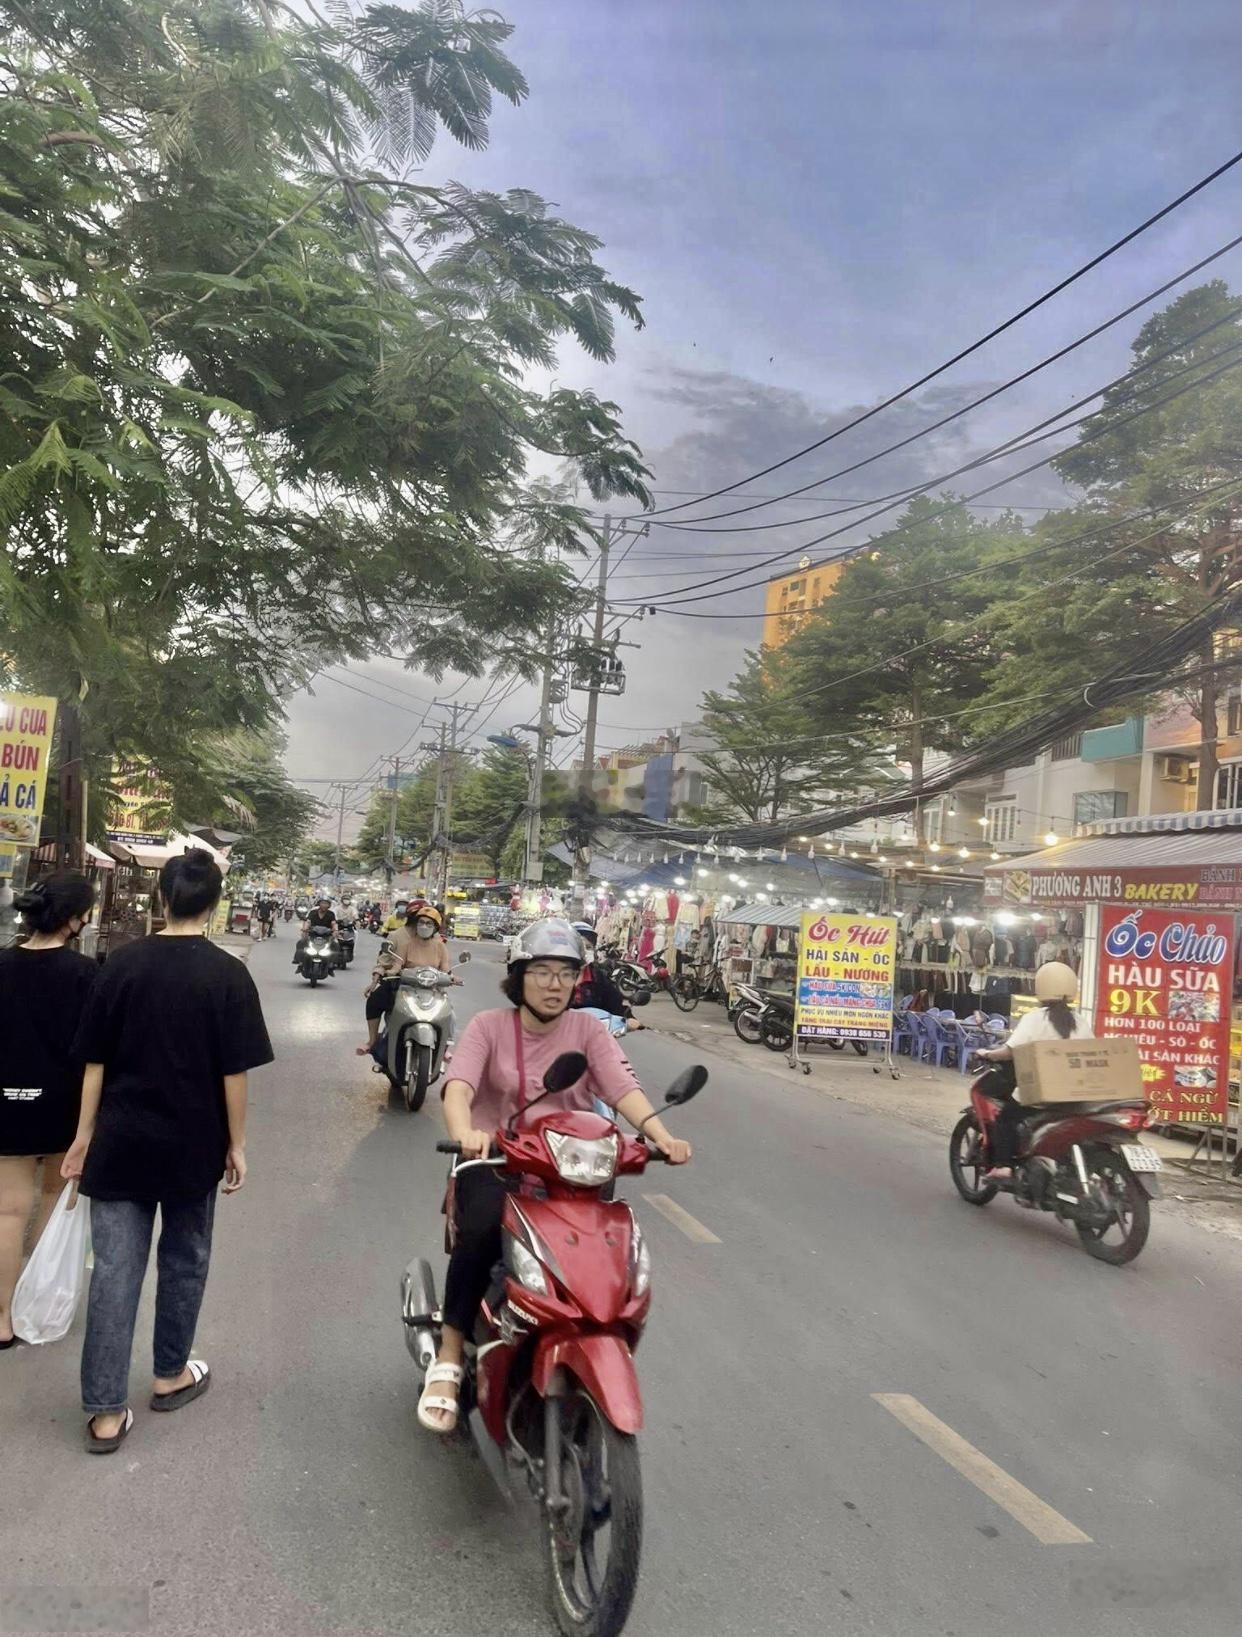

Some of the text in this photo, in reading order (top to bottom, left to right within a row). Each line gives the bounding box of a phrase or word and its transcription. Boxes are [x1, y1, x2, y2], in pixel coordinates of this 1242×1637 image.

[19, 706, 48, 736] CUA
[1, 740, 40, 772] BÚN
[15, 780, 37, 810] CÁ
[1032, 871, 1199, 901] PHƯƠNG ANH 3 BAKERY
[1105, 909, 1227, 965] Ốc Chảo
[806, 946, 828, 961] HẢI
[832, 948, 860, 964] SẢN
[873, 950, 890, 966] ỐC
[843, 966, 890, 981] NƯỚNG
[1108, 961, 1220, 992] HÀU SỮA
[1110, 989, 1161, 1016] 9K
[1104, 1016, 1201, 1034] HƠN 100 LOẠI
[1168, 1036, 1187, 1048] SÒ
[1199, 1036, 1217, 1050] ỐC
[1153, 1050, 1180, 1063] SẢN
[1184, 1052, 1220, 1065] KHÁC
[1149, 1088, 1219, 1105] CÁ NGỪ
[1178, 1106, 1224, 1123] HIỂM
